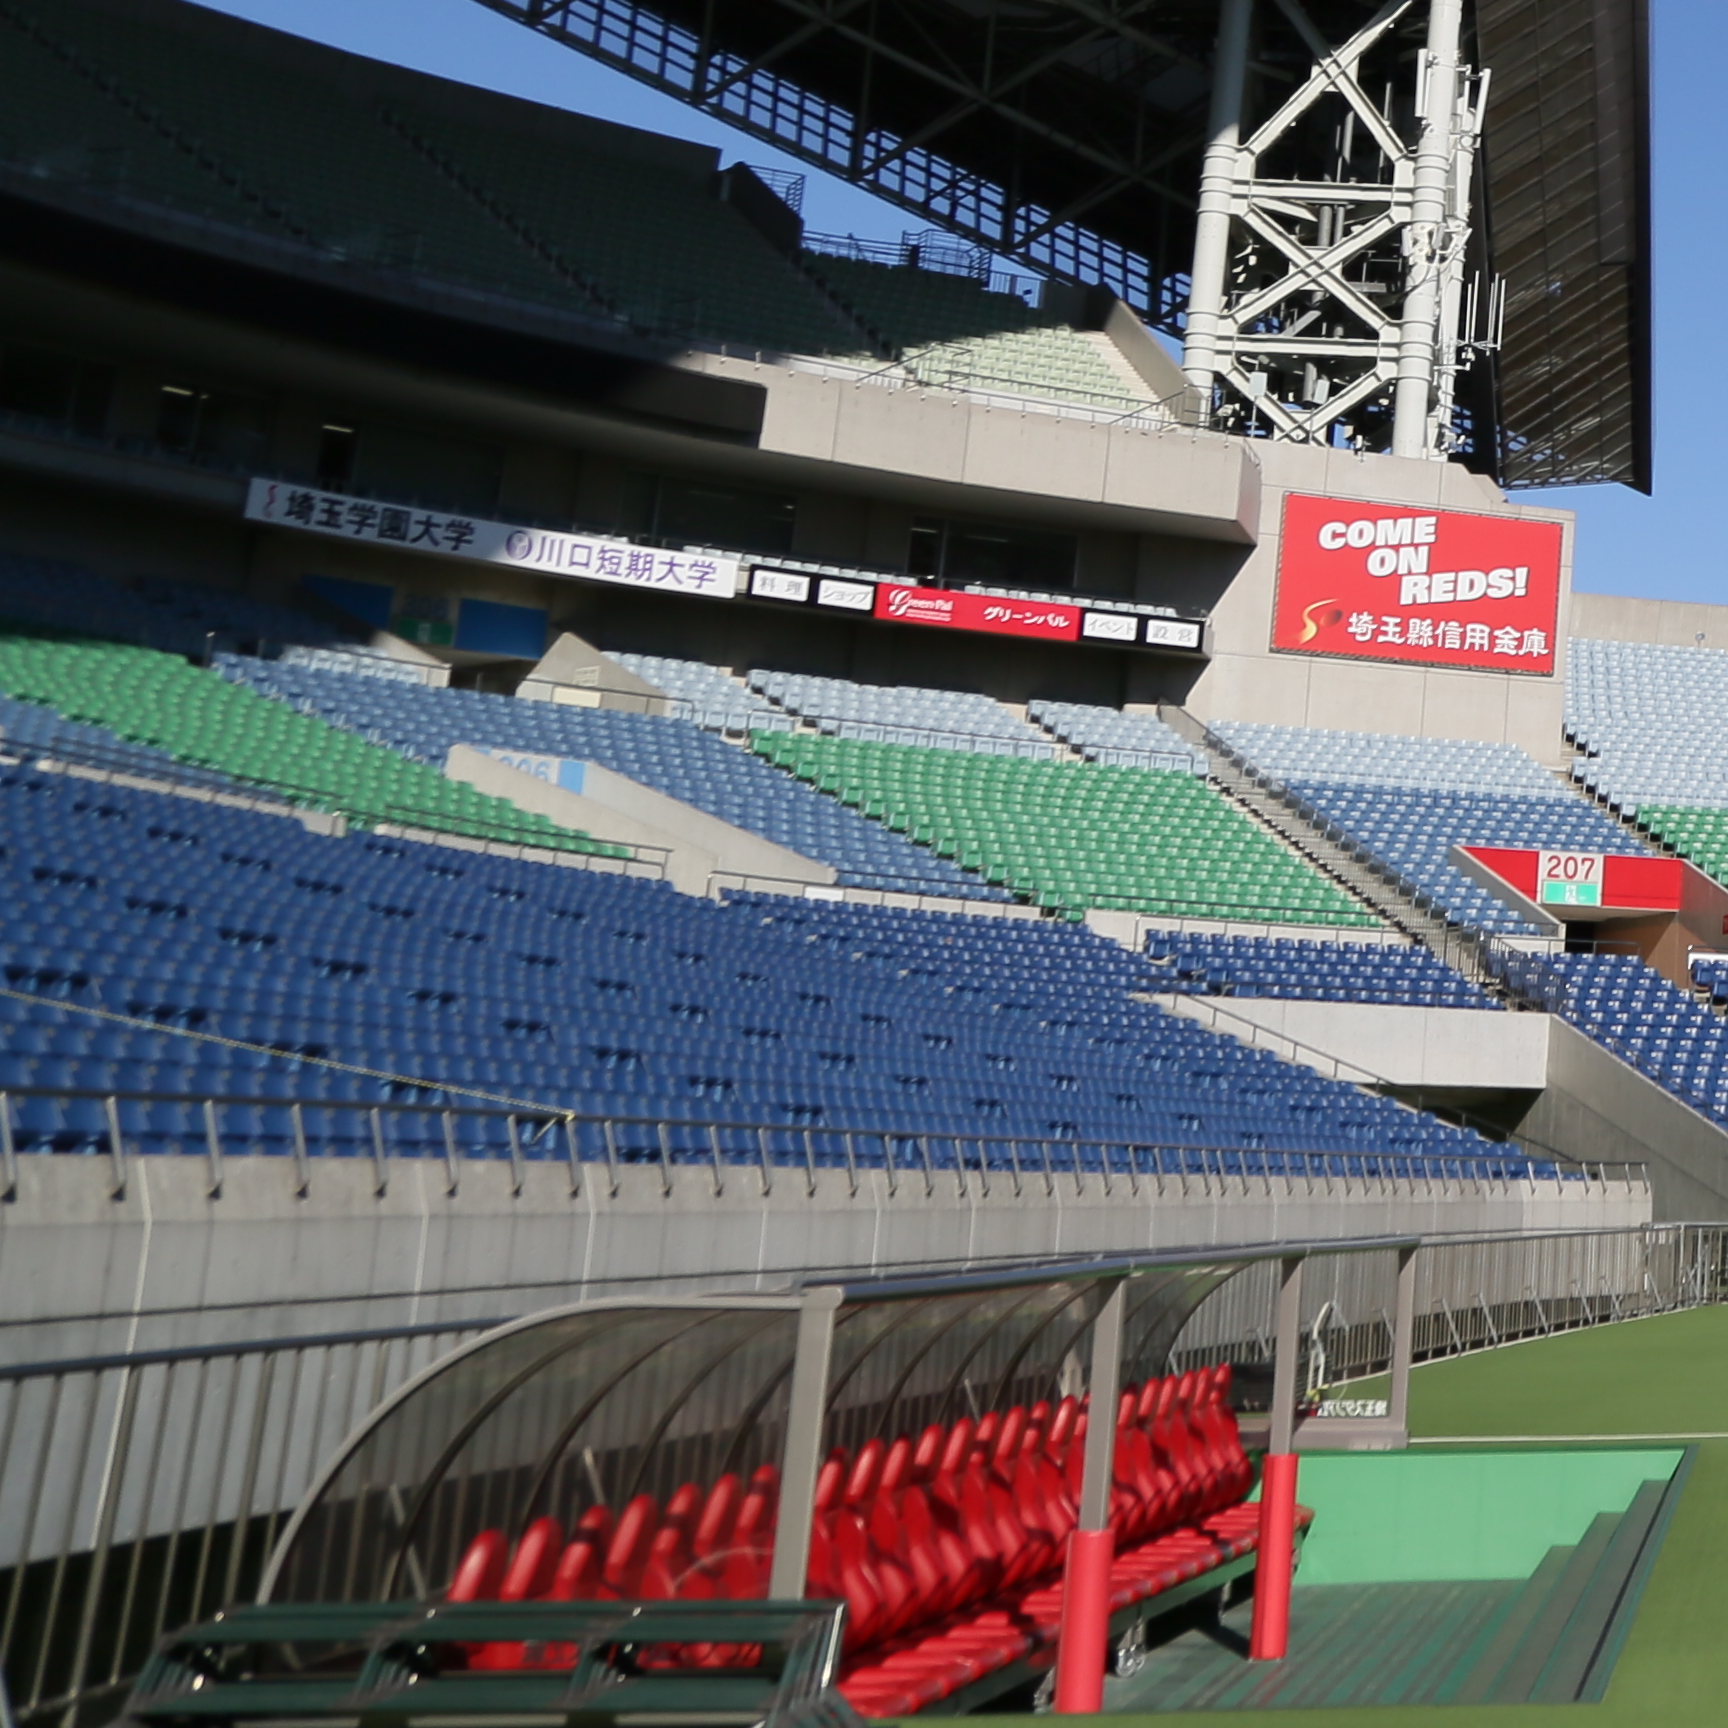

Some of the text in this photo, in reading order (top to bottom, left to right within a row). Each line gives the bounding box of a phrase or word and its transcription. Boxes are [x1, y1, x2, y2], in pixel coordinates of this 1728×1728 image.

[284, 489, 475, 551] 埼玉学園大学
[1318, 516, 1438, 550] COME
[535, 534, 718, 590] 川口短期大学
[1366, 545, 1430, 577] ON
[1399, 566, 1530, 606] REDS!
[1546, 855, 1596, 881] 207
